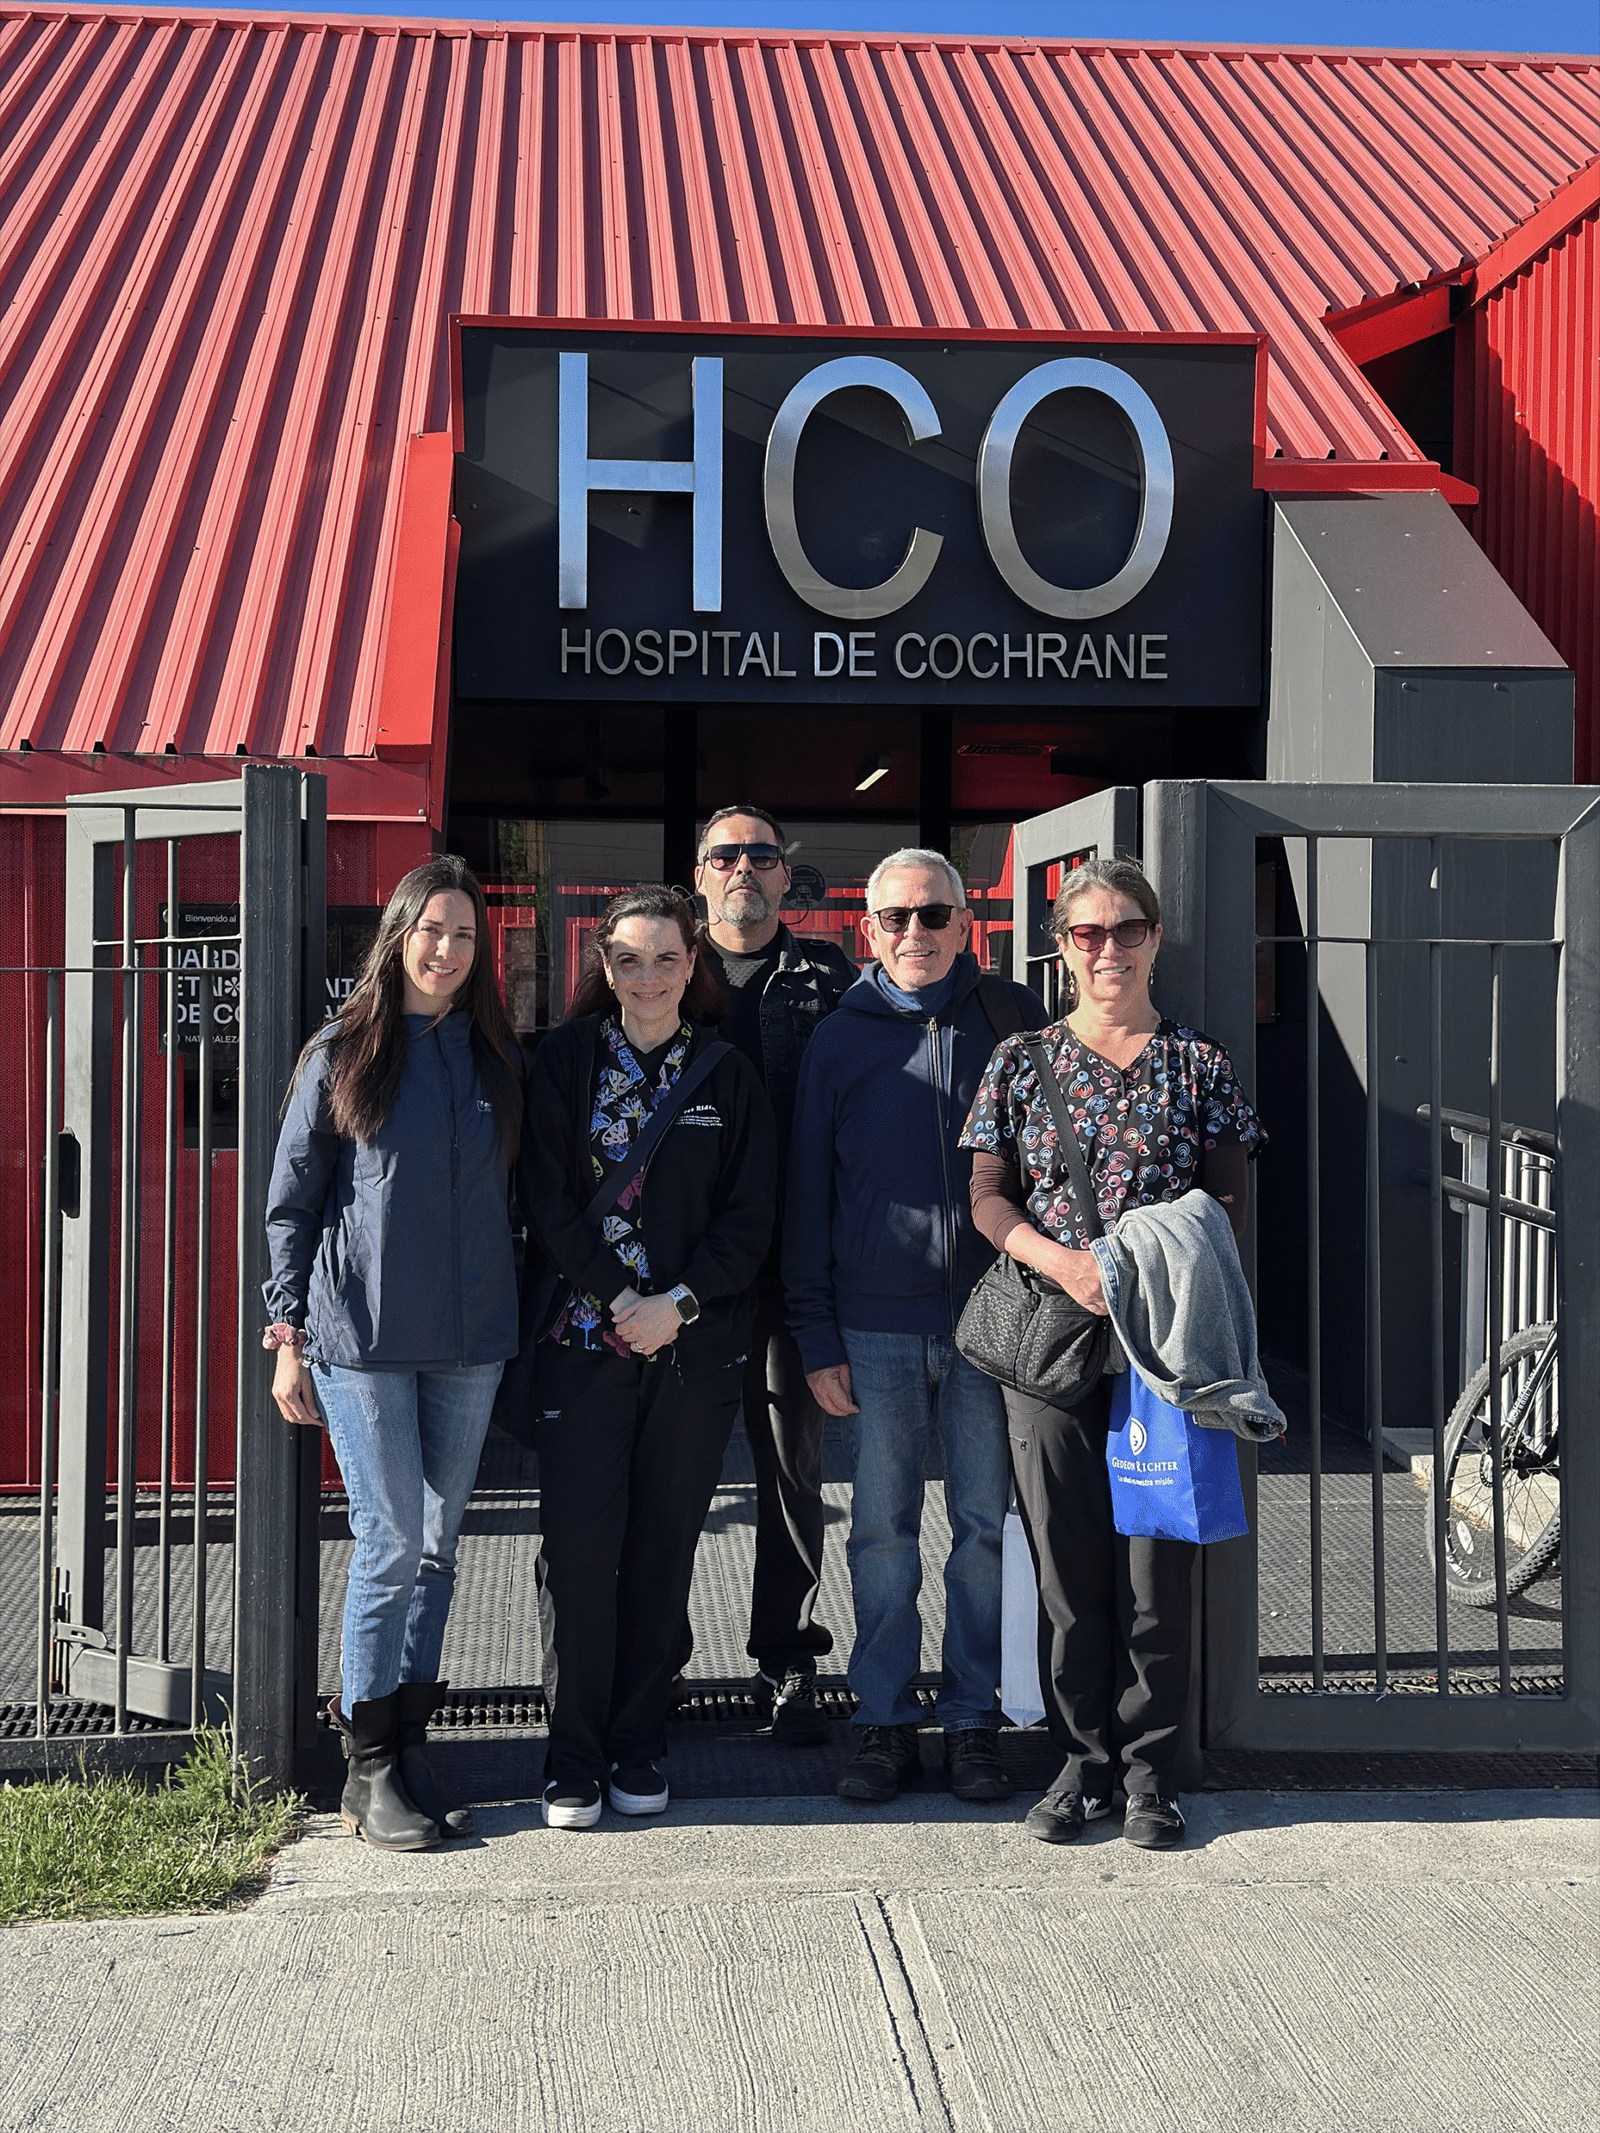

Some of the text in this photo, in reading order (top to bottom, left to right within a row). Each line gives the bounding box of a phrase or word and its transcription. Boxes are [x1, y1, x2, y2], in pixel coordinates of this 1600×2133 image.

[558, 352, 1175, 620] HCO
[561, 628, 1168, 679] HOSPITAL DE COCHRANE
[185, 914, 228, 922] Bienvenido
[185, 1035, 239, 1043] NATALEZ
[1136, 1461, 1178, 1472] RICHTER
